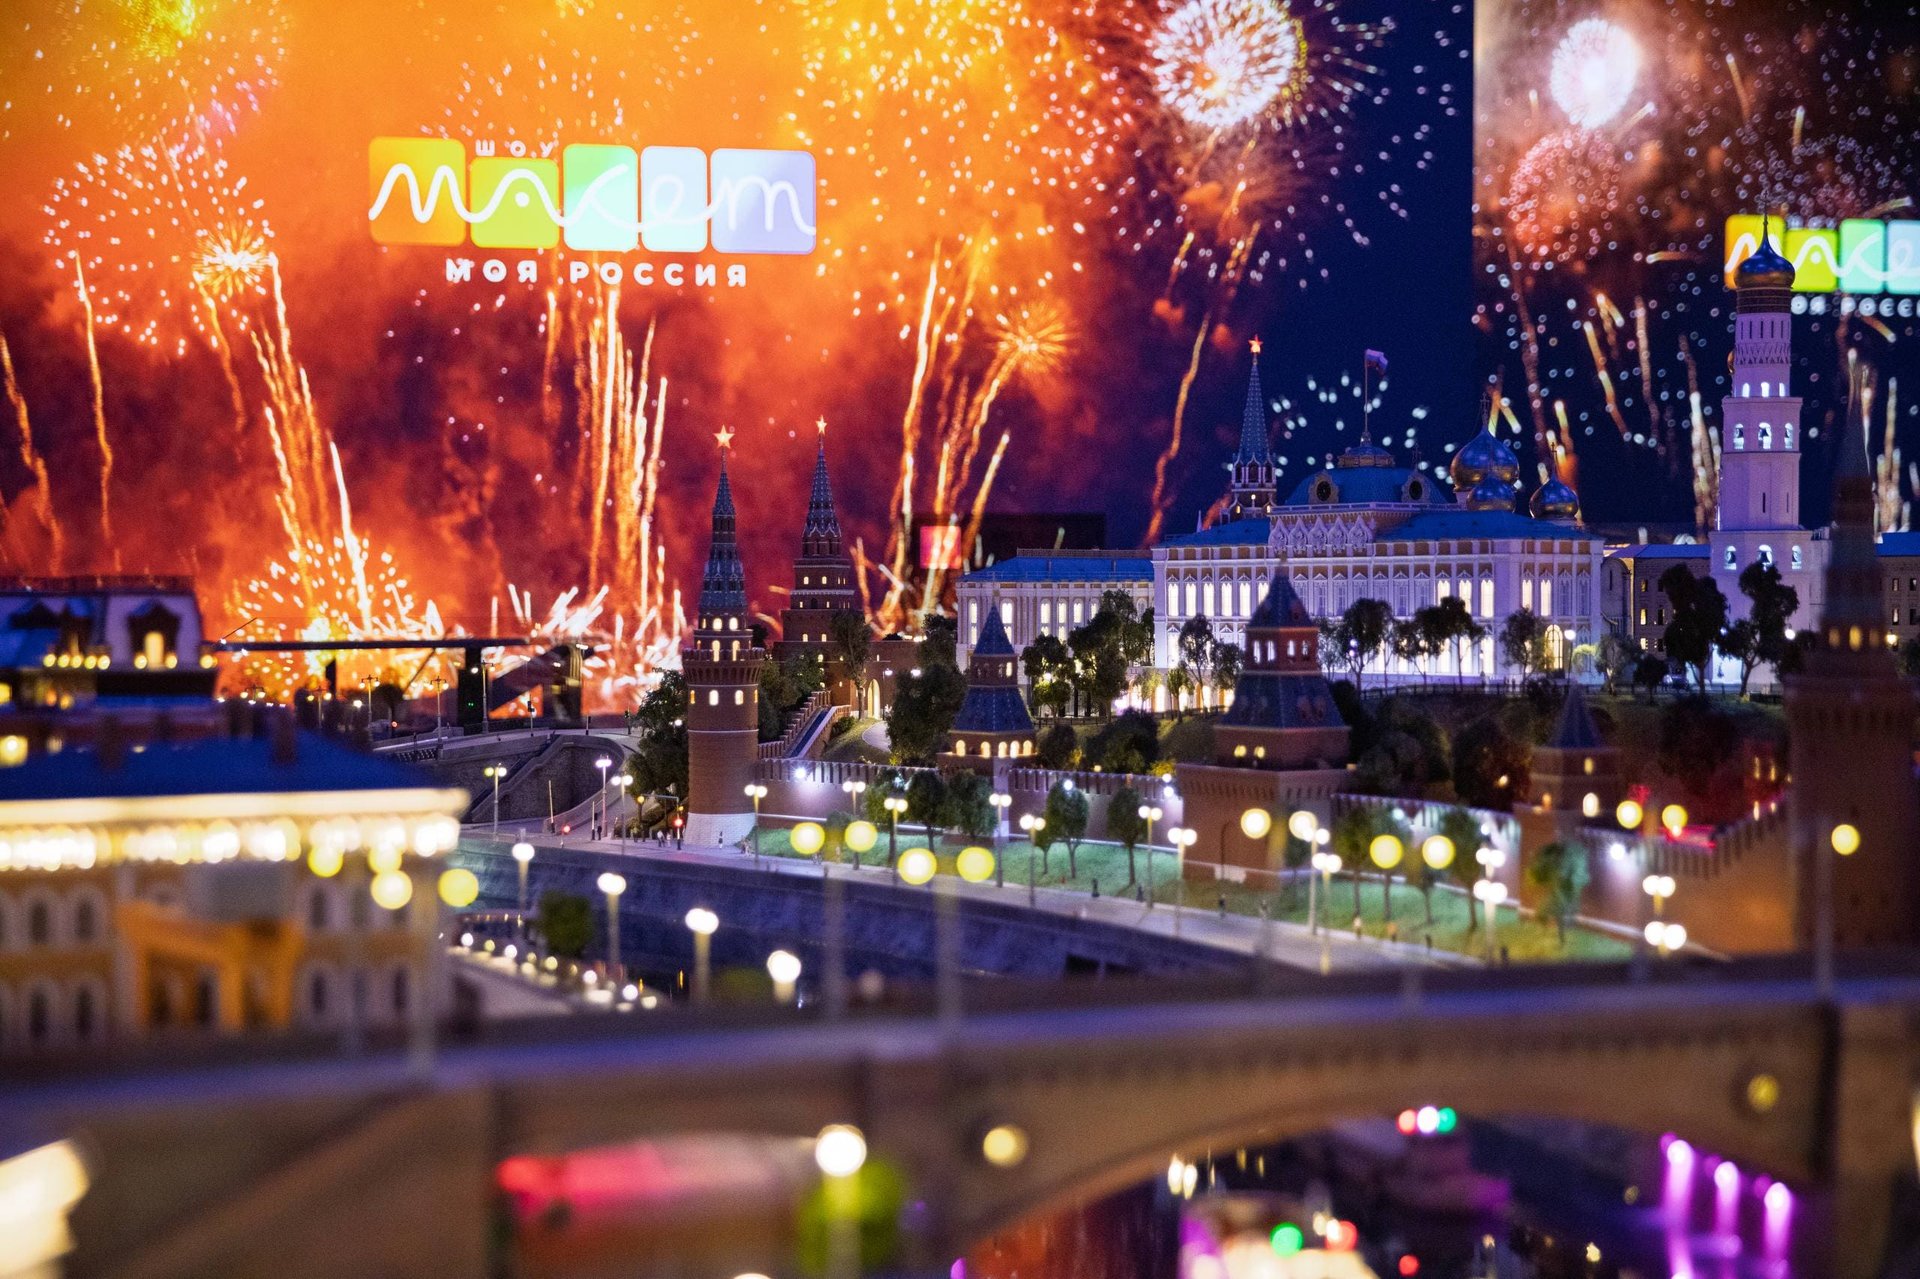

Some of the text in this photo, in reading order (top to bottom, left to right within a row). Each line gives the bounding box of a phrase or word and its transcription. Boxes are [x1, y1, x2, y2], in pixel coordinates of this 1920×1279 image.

[475, 139, 554, 158] ШОУ
[445, 257, 747, 287] МОЯ РОССИЯ
[1841, 297, 1920, 318] РОСС
